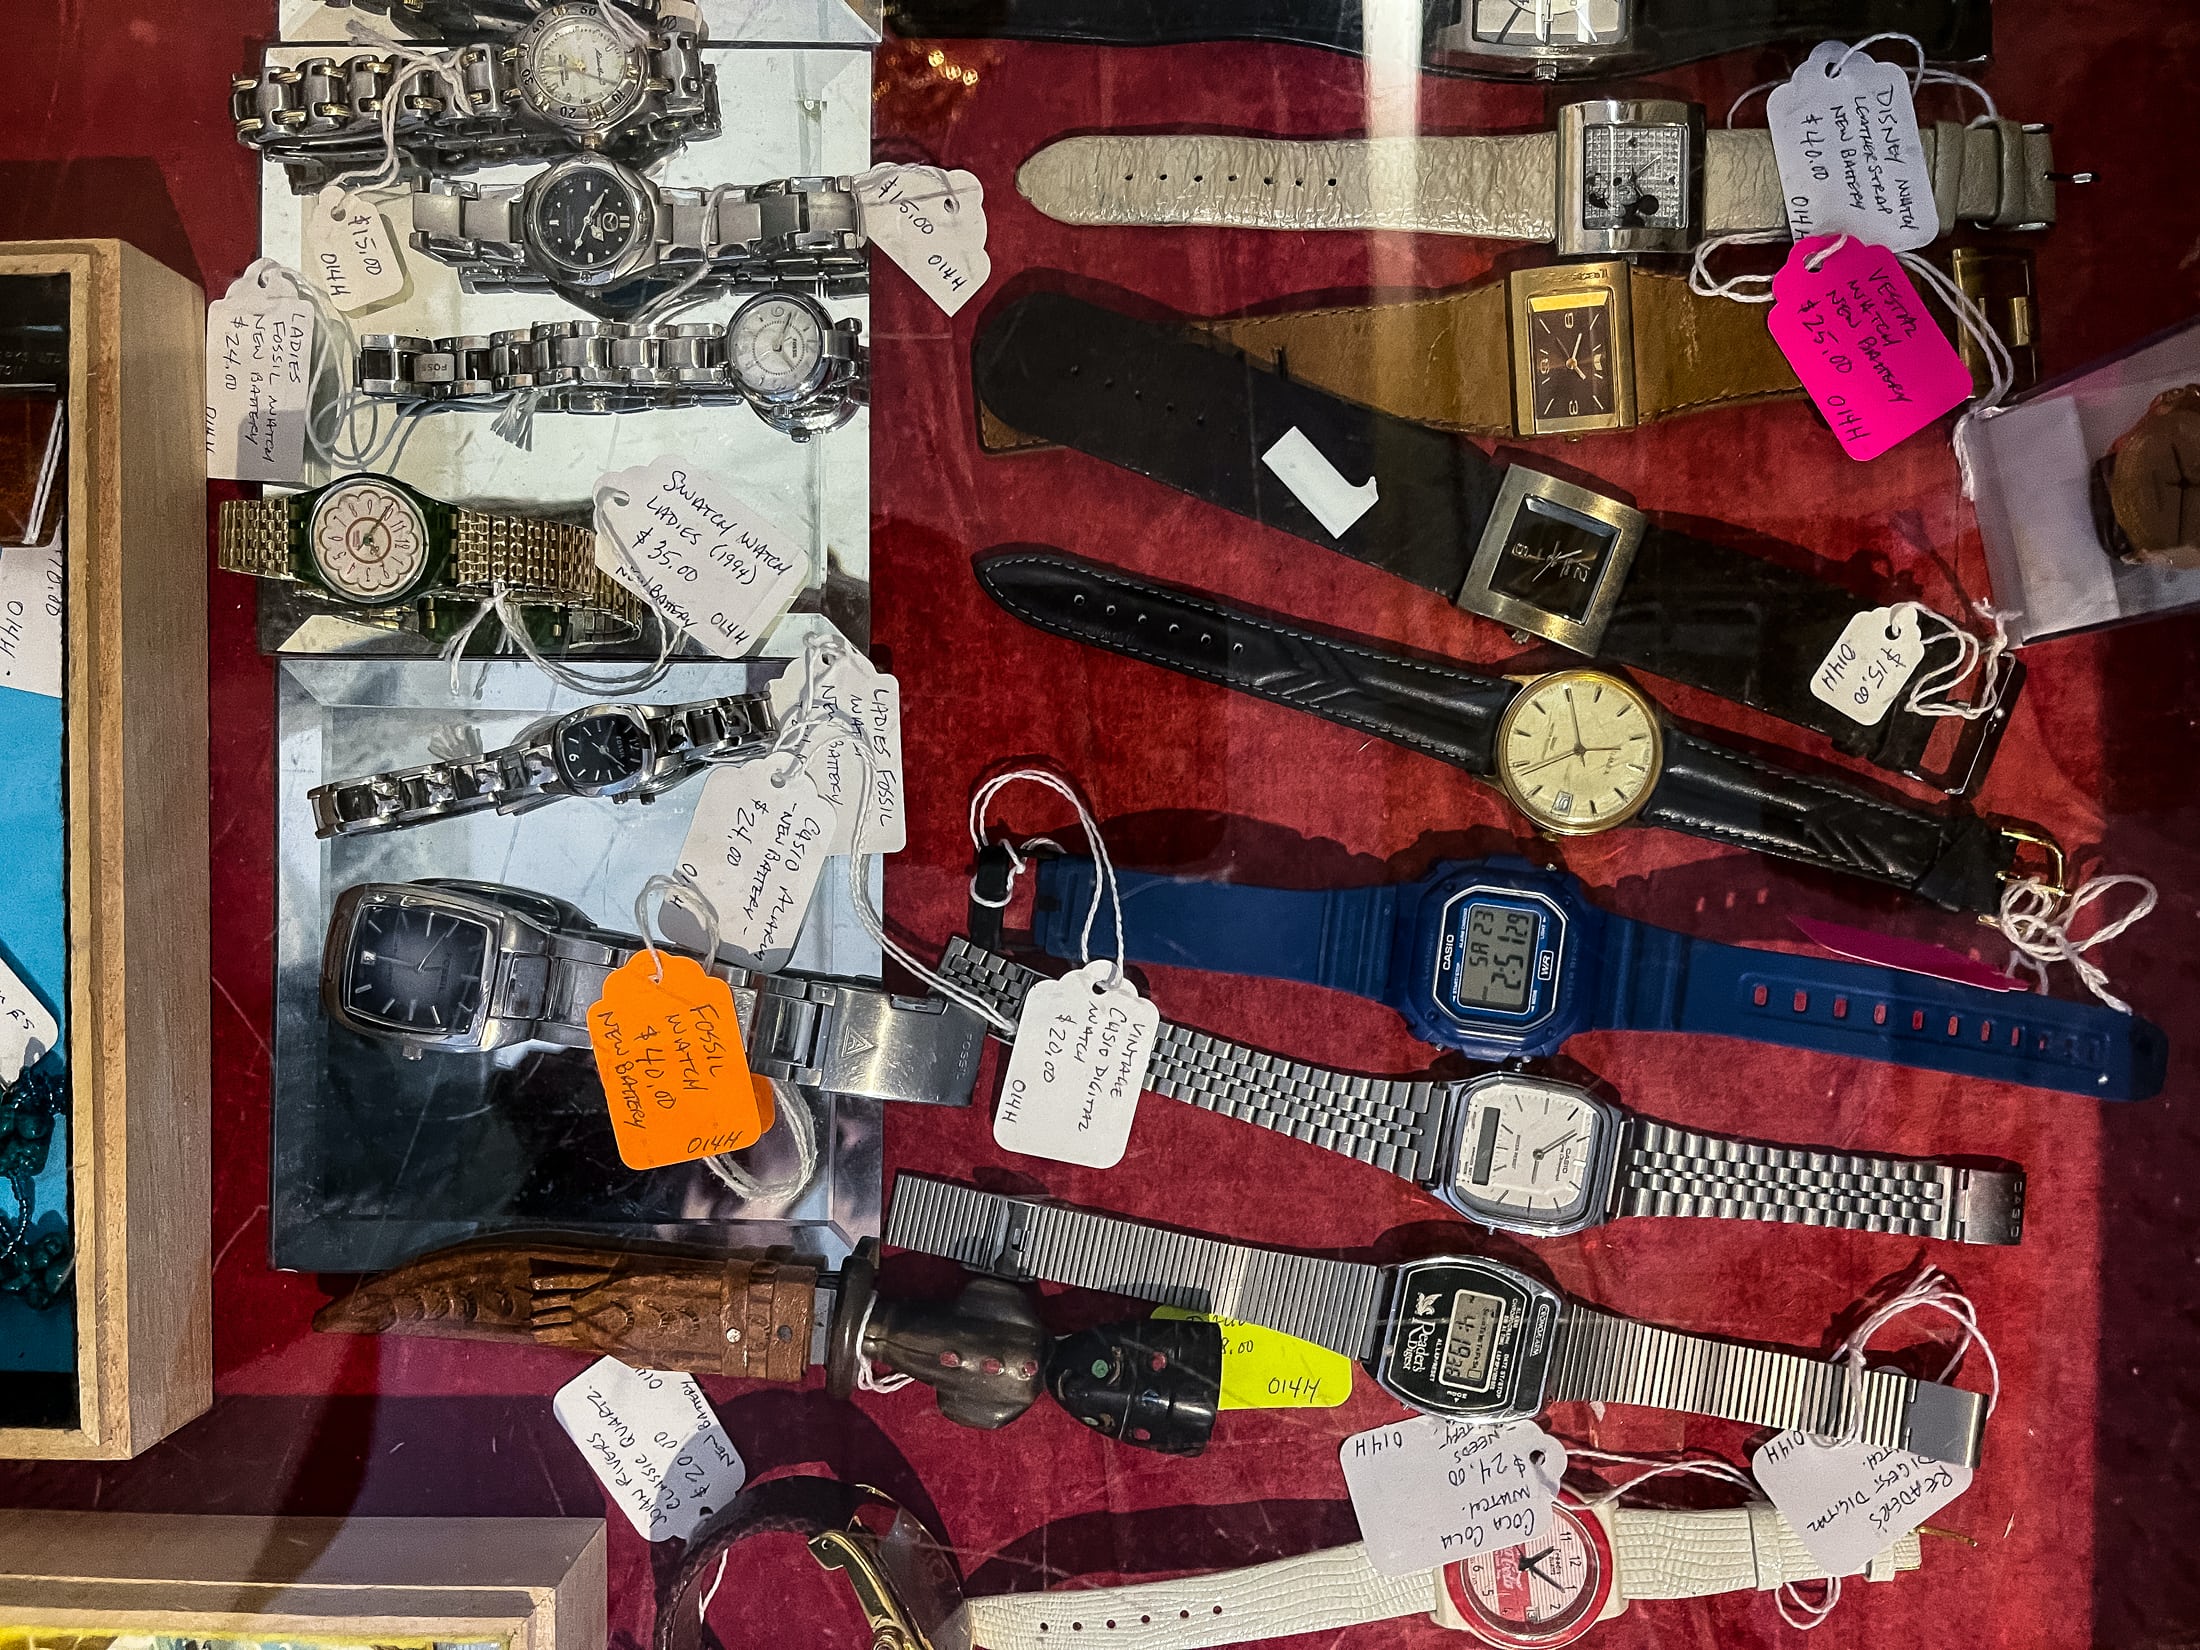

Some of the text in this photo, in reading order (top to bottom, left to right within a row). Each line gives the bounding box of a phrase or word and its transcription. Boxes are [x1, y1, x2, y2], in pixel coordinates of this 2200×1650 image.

[532, 20, 545, 33] 40
[580, 5, 597, 16] 50
[521, 69, 534, 85] 30
[612, 88, 626, 104] 10
[559, 105, 577, 119] 20
[1877, 84, 1905, 165] DISNEY
[1799, 114, 1829, 181] $40.00
[1830, 105, 1867, 211] NEW BATTERY
[879, 175, 934, 235] $15.00
[347, 215, 383, 275] $15.00
[319, 252, 352, 297] 014H
[927, 253, 968, 293] 014H
[223, 315, 250, 391] $24.00
[289, 313, 306, 384] LADIES
[1798, 298, 1853, 376] $25.00
[1825, 289, 1913, 404] NEW BATTERY
[244, 313, 266, 446] NEW BATTERY
[262, 320, 286, 463] FOSSIL WATCH
[1568, 400, 1579, 415] 3
[1826, 394, 1872, 442] 014H
[645, 494, 760, 586] LADIES (1994)
[662, 468, 794, 578] SWATCH WATCH
[648, 583, 700, 630] BATTERY
[709, 611, 752, 646] 014H
[1821, 643, 1857, 692] 014H
[1853, 647, 1907, 705] $15.00
[616, 735, 625, 759] FOSSIL
[850, 694, 864, 757] WATH
[568, 752, 580, 763] 6
[869, 688, 897, 828] LADIES FOSSIL
[726, 798, 770, 868] $24.00
[668, 862, 700, 910] 01H
[742, 847, 782, 922] BATTERY
[1442, 934, 1455, 971] CASIO
[1469, 910, 1494, 968] SA 23
[1541, 954, 1552, 977] WR
[664, 1012, 709, 1091] WATCH
[689, 1002, 725, 1079] FOSSIL
[1042, 1013, 1078, 1084] $20.00
[596, 1009, 647, 1130] NEW BATTERY
[634, 1025, 677, 1110] $40.00
[1001, 1078, 1026, 1125] 014H
[686, 1130, 744, 1155] 014H
[1561, 1148, 1572, 1174] CASIO
[1221, 1339, 1255, 1356] 8.00
[1402, 1338, 1414, 1370] Digest
[1411, 1320, 1434, 1373] Reader's
[1267, 1375, 1322, 1404] 014H
[681, 1380, 736, 1468] NEW BATTERY
[1355, 1431, 1403, 1457] 014H
[1454, 1429, 1501, 1464] NEEDS
[1767, 1429, 1805, 1465] 014H
[585, 1432, 632, 1488] RIVERS
[653, 1431, 711, 1500] $20.00
[1447, 1453, 1527, 1486] $24.00
[1868, 1464, 1954, 1534] READER'S
[1439, 1507, 1536, 1550] COCA COLA
[1559, 1531, 1572, 1541] 11
[1471, 1565, 1481, 1573] 6
[1569, 1555, 1582, 1568] 12
[1482, 1589, 1495, 1597] 5
[1550, 1603, 1561, 1611] 2
